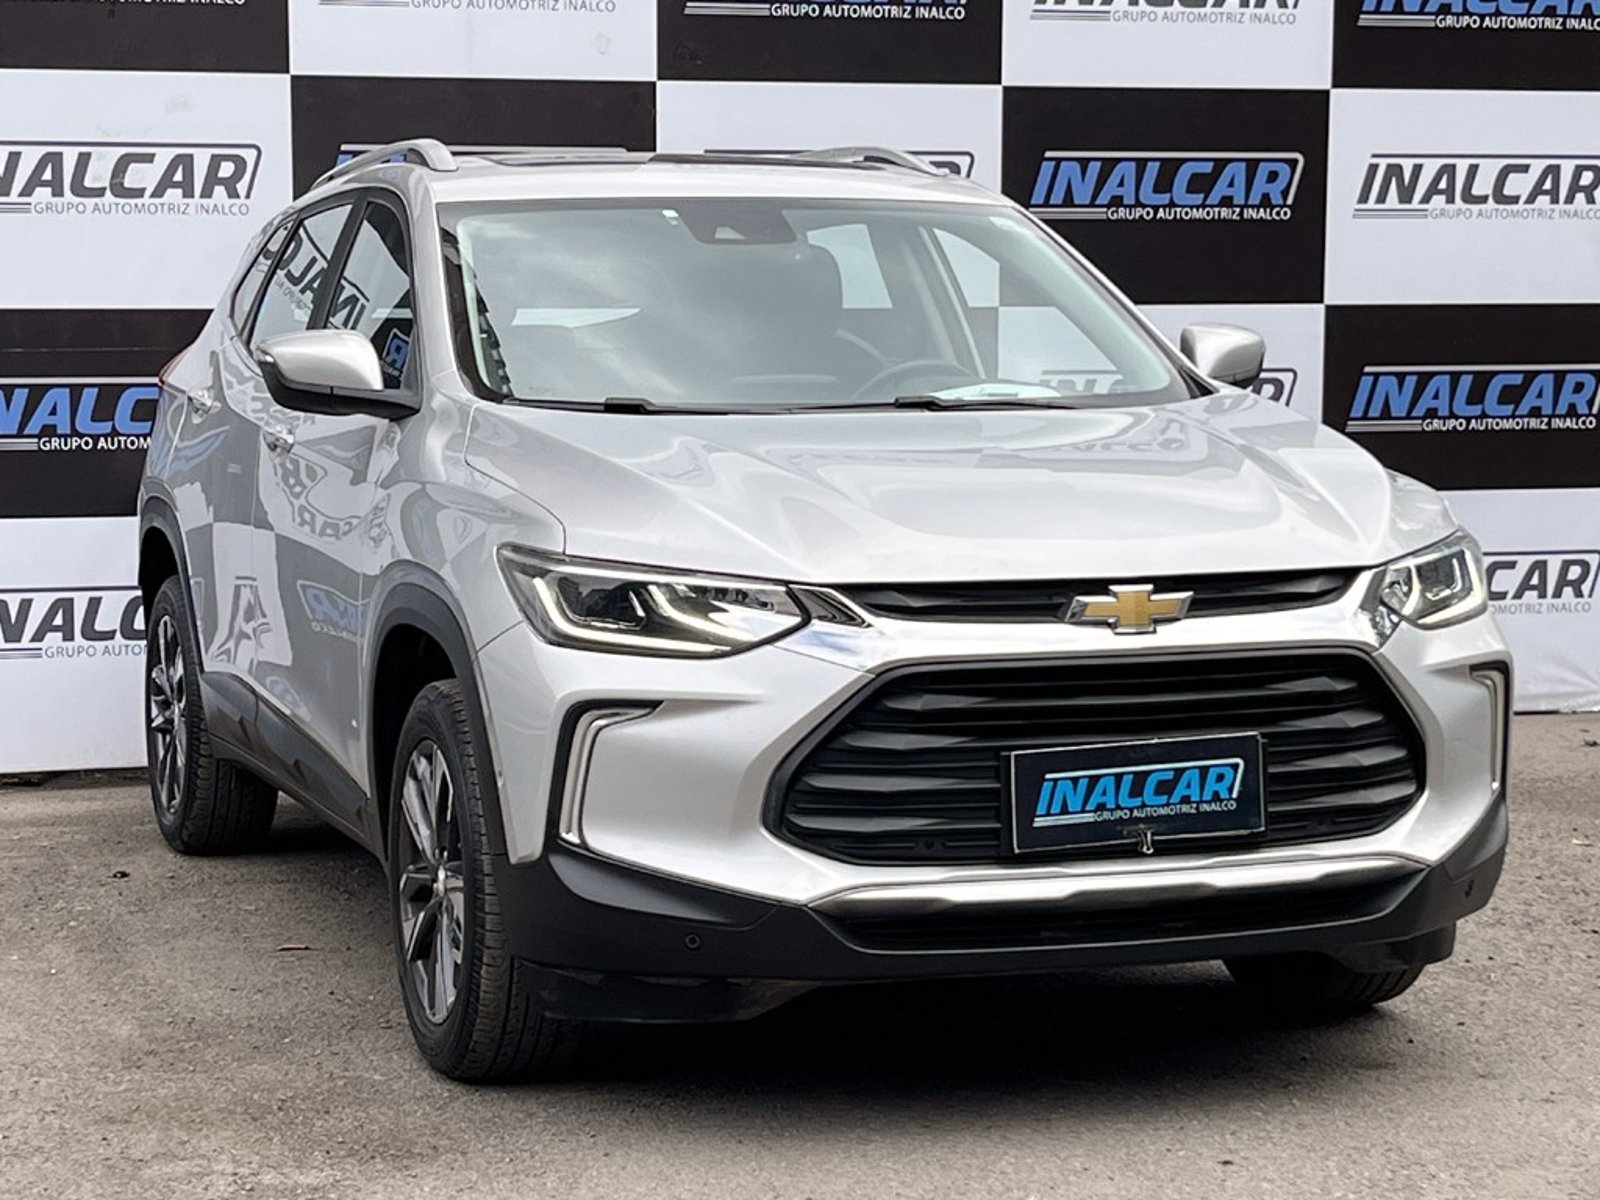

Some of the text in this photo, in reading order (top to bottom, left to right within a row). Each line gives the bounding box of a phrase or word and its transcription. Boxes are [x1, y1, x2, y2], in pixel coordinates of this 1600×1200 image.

[466, 0, 559, 11] AUTOMOTRIZ
[564, 0, 616, 13] INALCO
[771, 3, 965, 20] GRUPO AUTOMOTRIZ INALCO
[1112, 10, 1297, 25] GRUPO AUTOMOTRIZ INALCO
[1436, 15, 1480, 29] GRUPO
[1482, 15, 1563, 30] AUTOMOTRIZ
[1030, 160, 1291, 206] INALCAR
[1356, 163, 1600, 206] INALCAR
[33, 201, 250, 217] GRUPO AUTOMOTRIZ INALCO
[1107, 207, 1292, 221] GRUPO AUTOMOTRIZ INALCO
[1429, 207, 1473, 221] GRUPO
[1476, 207, 1555, 221] AUTOMOTRIZ
[1350, 373, 1597, 418] INALCAR
[1422, 416, 1597, 431] GRUPO AUTOMOTRIZ INALCO
[39, 437, 94, 450] GRUPO
[1546, 601, 1592, 614] INALCO
[44, 643, 148, 659] GRUPO AUTO
[1035, 766, 1236, 816] INALCAR
[1094, 799, 1237, 822] GRUPO AUTOMOTRIZ INALCO
